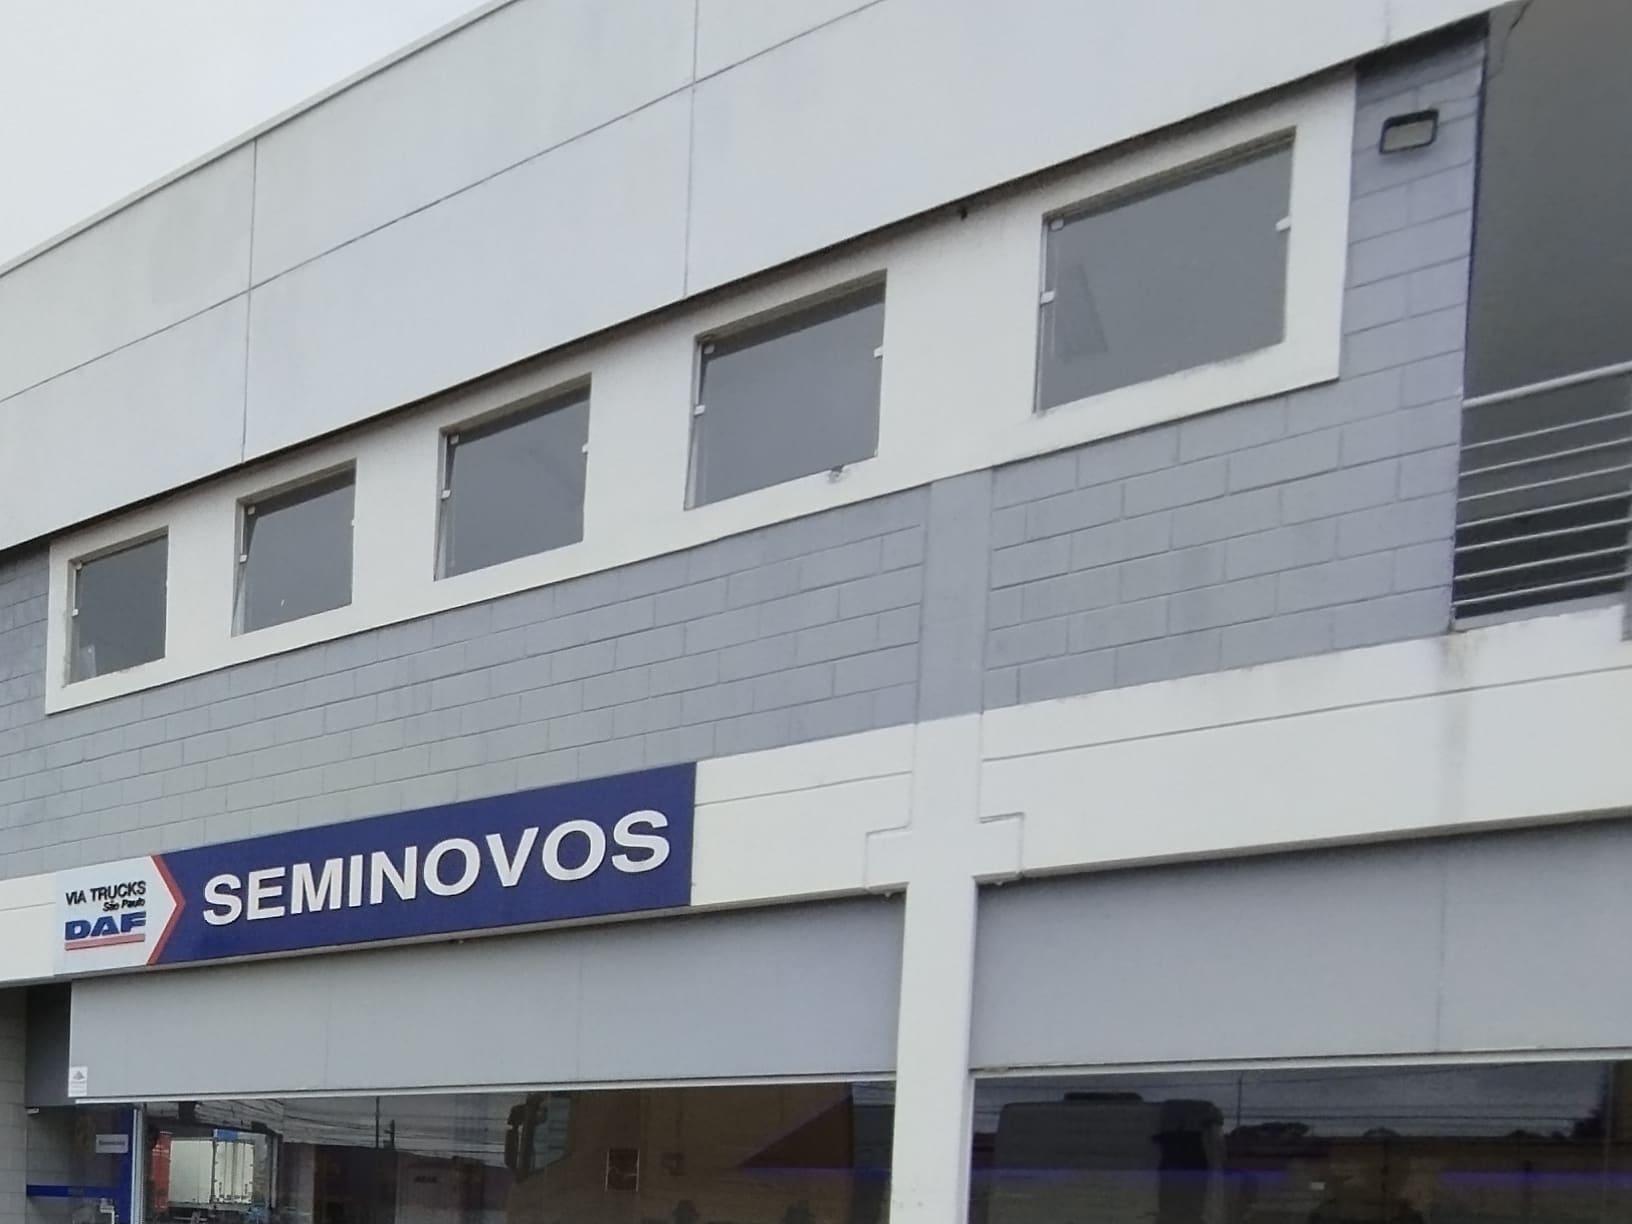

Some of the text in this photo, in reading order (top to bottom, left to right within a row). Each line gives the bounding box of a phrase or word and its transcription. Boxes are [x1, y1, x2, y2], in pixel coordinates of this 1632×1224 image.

[202, 809, 670, 927] SEMINOVOS
[65, 880, 146, 906] VIA TRUCKS
[102, 898, 146, 912] São Paulo
[65, 911, 146, 941] DAF
